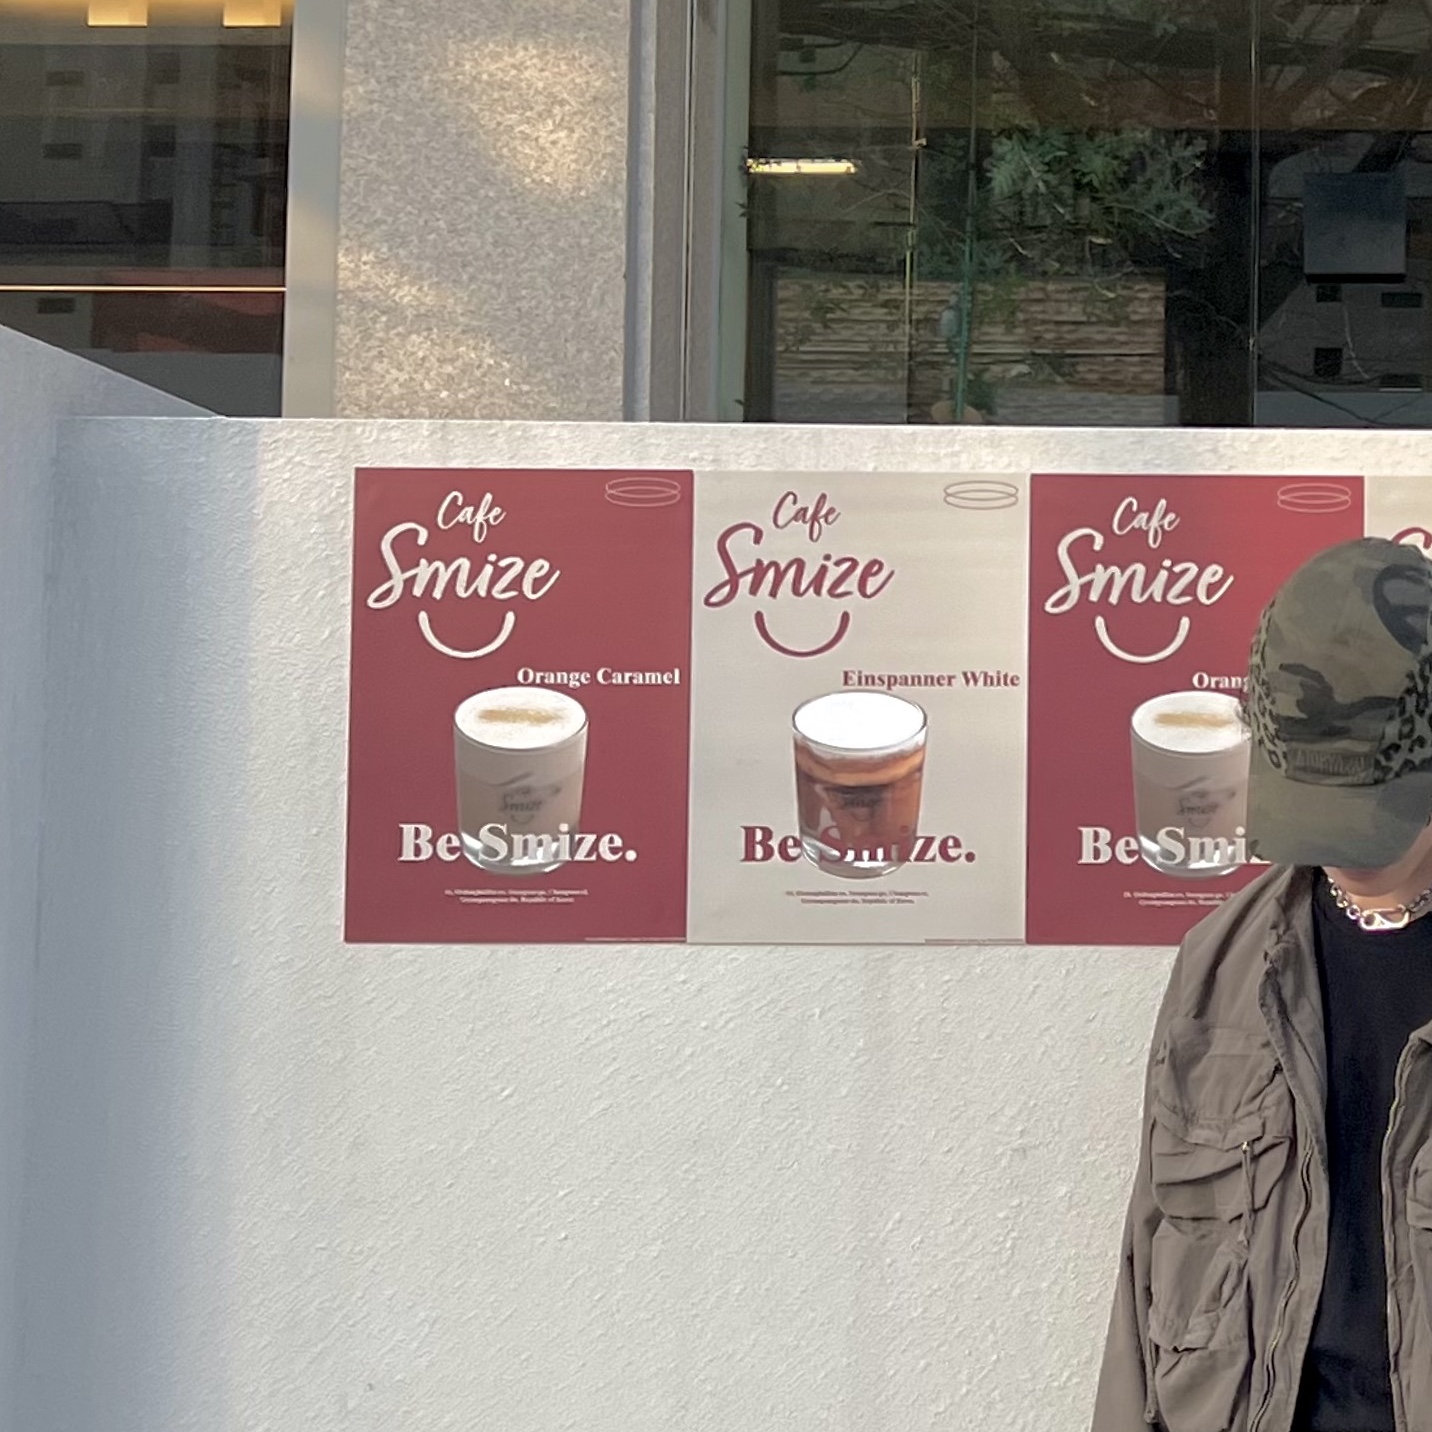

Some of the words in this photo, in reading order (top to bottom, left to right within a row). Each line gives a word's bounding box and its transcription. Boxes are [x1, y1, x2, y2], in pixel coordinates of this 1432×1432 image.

[437, 490, 506, 543] Cafe
[772, 490, 841, 543] Cafe
[1112, 496, 1180, 549] Cafe
[367, 522, 561, 609] Smize
[703, 524, 894, 607] Smize
[1044, 528, 1234, 615] Smize
[517, 667, 591, 688] Orange
[596, 667, 680, 685] Caramel
[842, 670, 956, 691] Einspanner
[961, 670, 1020, 687] White
[398, 823, 461, 862] Be
[478, 822, 637, 863] Smize.
[741, 826, 800, 862] Be
[1077, 826, 1140, 865] Be
